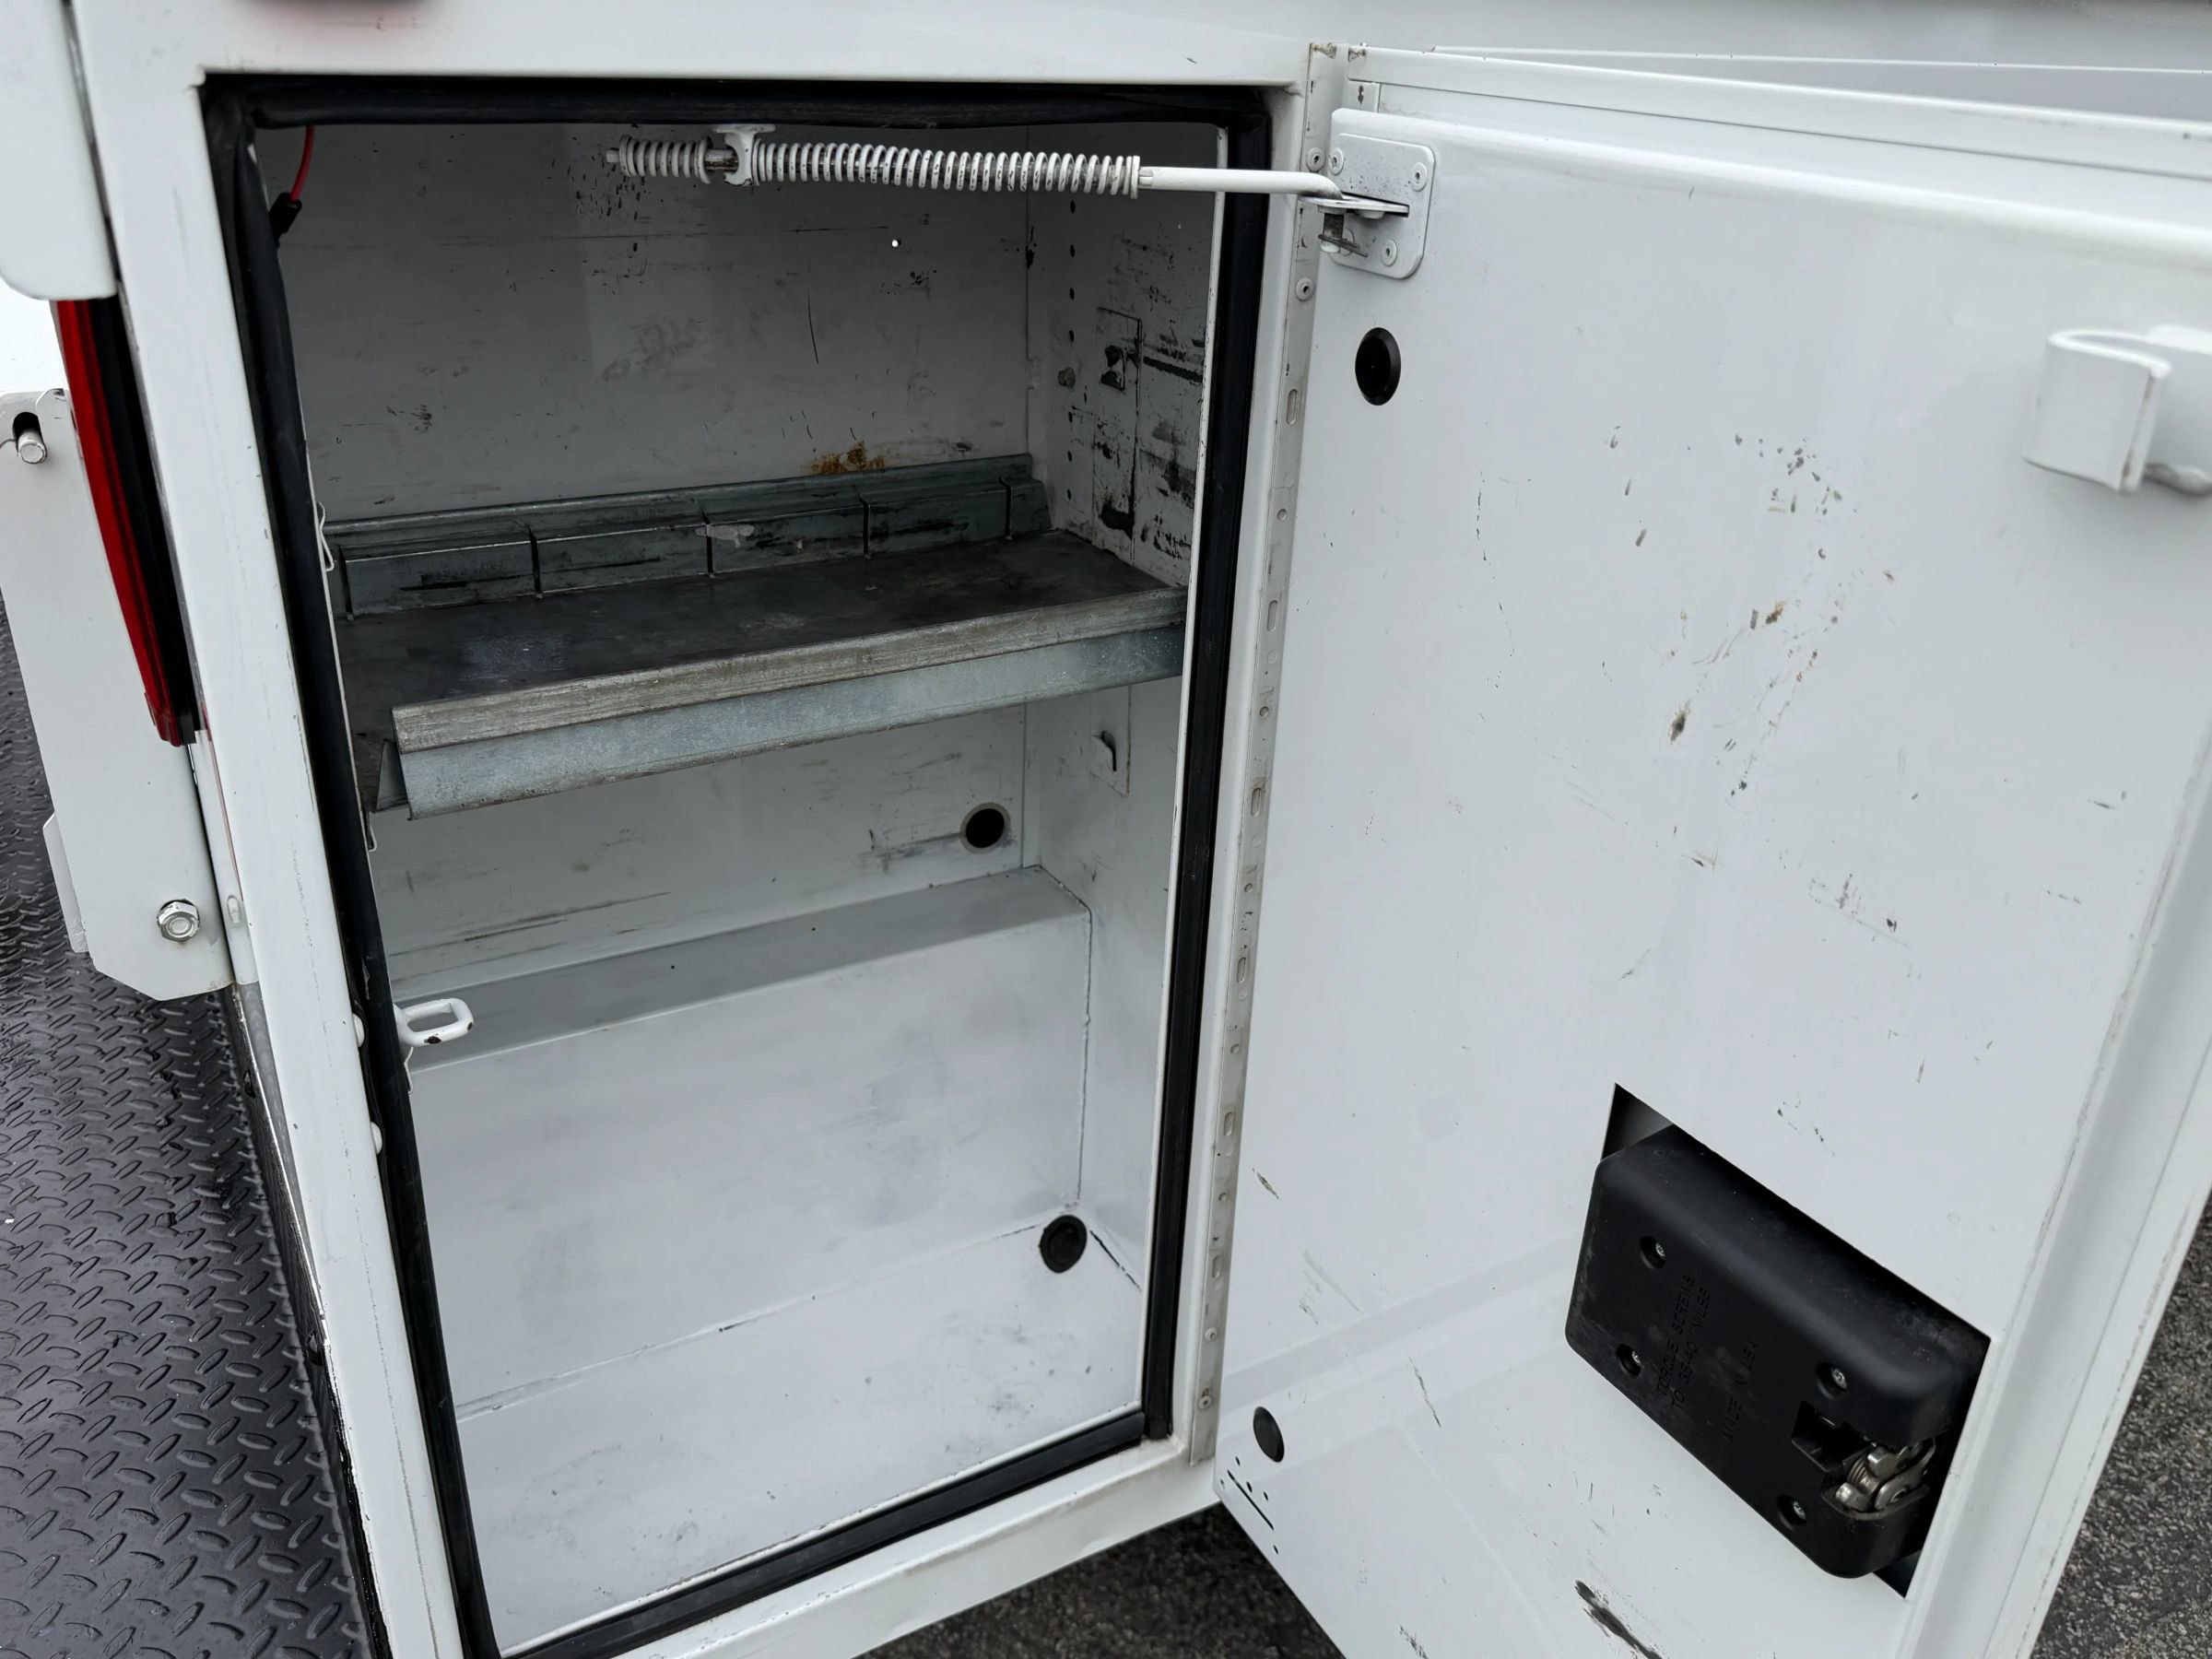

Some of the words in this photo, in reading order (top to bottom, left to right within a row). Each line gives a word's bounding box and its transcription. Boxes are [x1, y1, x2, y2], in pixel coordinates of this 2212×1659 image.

[1656, 1339, 1679, 1395] TORQUE
[1672, 1275, 1694, 1335] SCREWS
[1678, 1340, 1698, 1385] 35-40
[1671, 1389, 1686, 1409] TO
[1720, 1396, 1742, 1444] MADE
[1733, 1373, 1747, 1394] IN
[1740, 1340, 1760, 1371] USA
